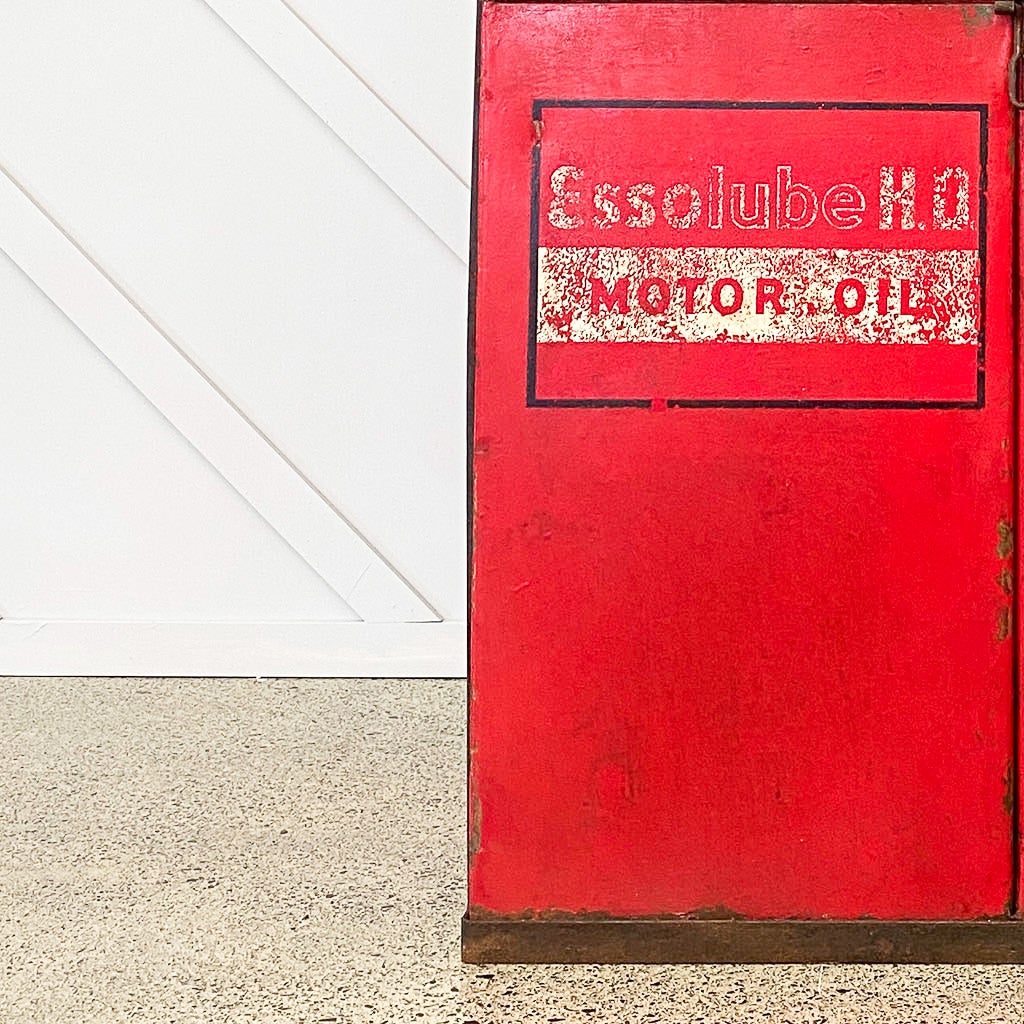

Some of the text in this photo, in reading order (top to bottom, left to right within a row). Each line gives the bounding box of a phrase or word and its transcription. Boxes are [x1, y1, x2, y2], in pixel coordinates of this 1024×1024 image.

[547, 165, 866, 231] Essolube
[588, 277, 920, 316] MOTOR OIL
